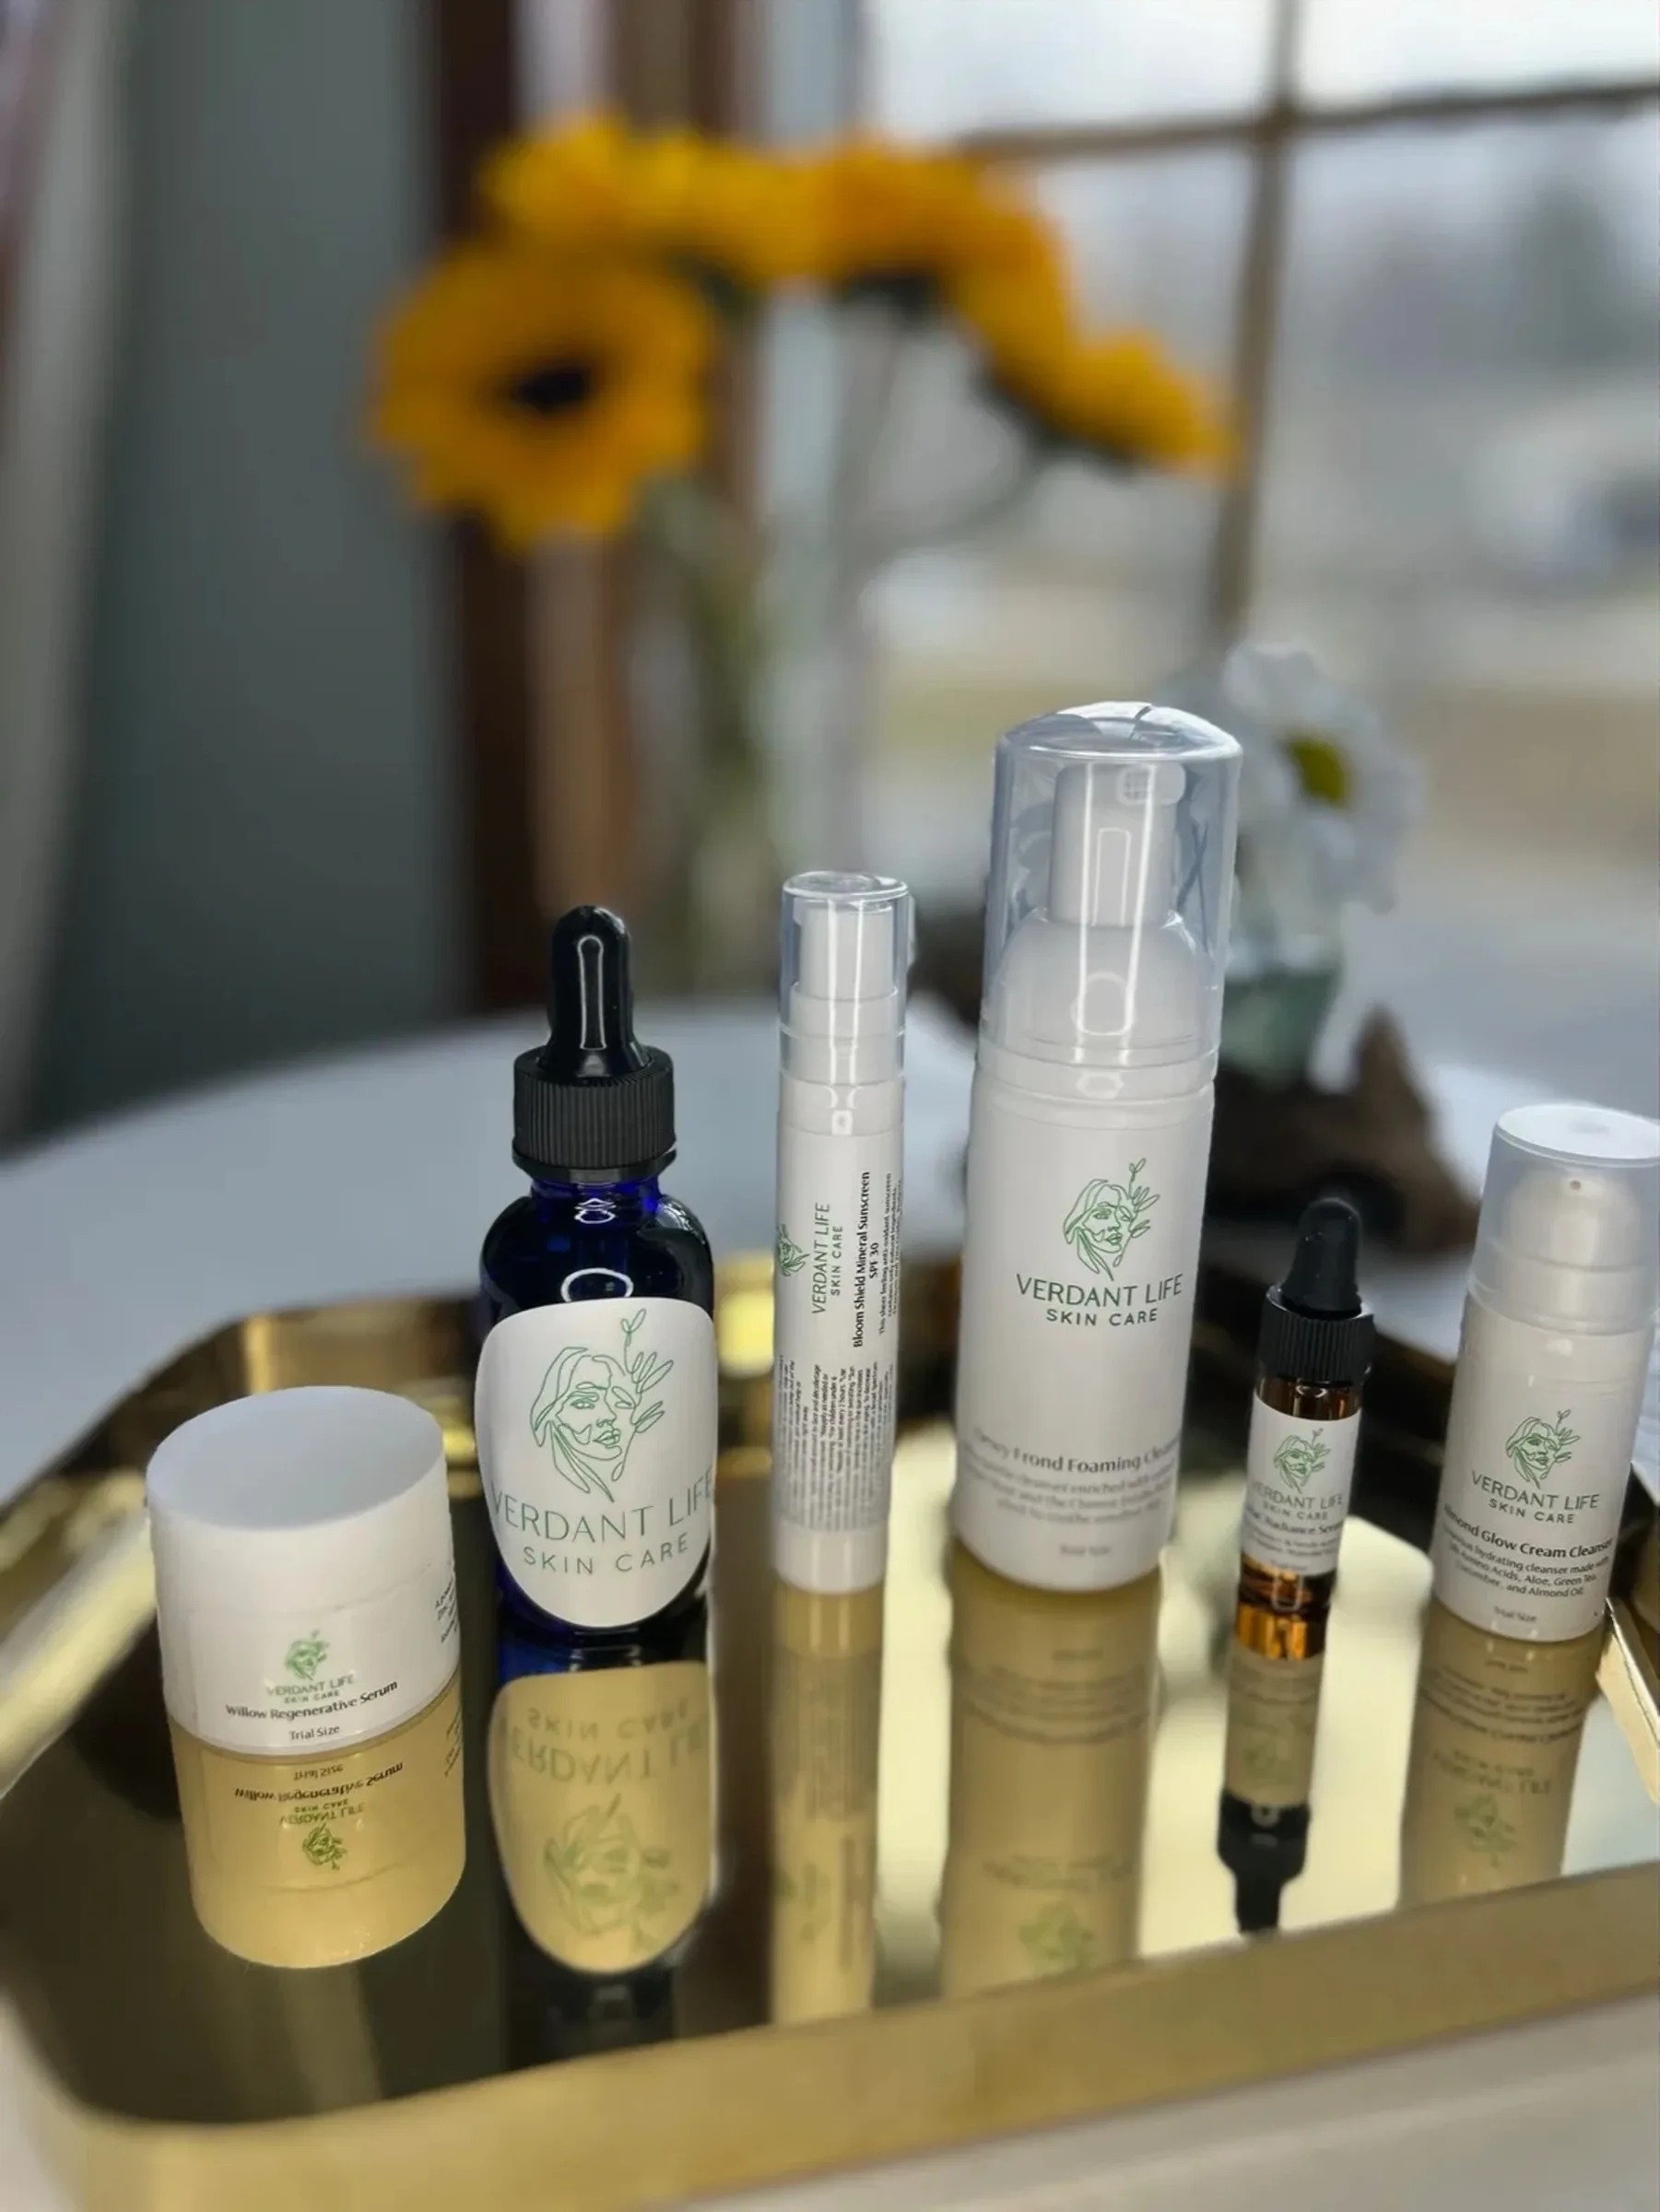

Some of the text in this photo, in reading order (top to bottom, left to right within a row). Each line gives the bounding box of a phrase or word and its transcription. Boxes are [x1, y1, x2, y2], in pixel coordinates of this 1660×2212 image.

[812, 1202, 830, 1314] VERDANT LIFE
[830, 1226, 842, 1296] SKIN CARE
[853, 1171, 870, 1348] Bloom Shield Mineral Sunscreen
[869, 1242, 879, 1279] SPF 30
[1017, 1274, 1183, 1307] VERDANT LIFE
[1046, 1308, 1158, 1326] SKIN CARE
[1067, 1456, 1142, 1473] Foaming
[1471, 1469, 1600, 1511] VERDANT LIFE
[489, 1479, 653, 1543] VERDANT
[1489, 1498, 1575, 1524] SKIN CARE
[523, 1532, 689, 1574] SKIN CARE
[1475, 1544, 1524, 1572] hydrating
[1525, 1563, 1568, 1575] cleanser
[1570, 1561, 1595, 1574] made
[1481, 1529, 1517, 1551] Glow
[1520, 1542, 1566, 1559] Cream
[1569, 1537, 1613, 1559] Cleanser
[1527, 1582, 1569, 1598] Almond
[1554, 1575, 1582, 1587] Green
[225, 1680, 398, 1722] Willow Regenerative Serum
[265, 1674, 354, 1697] VERDANT LIFE
[284, 1689, 340, 1704] SKIN CARE
[289, 1724, 340, 1741] Trial Size
